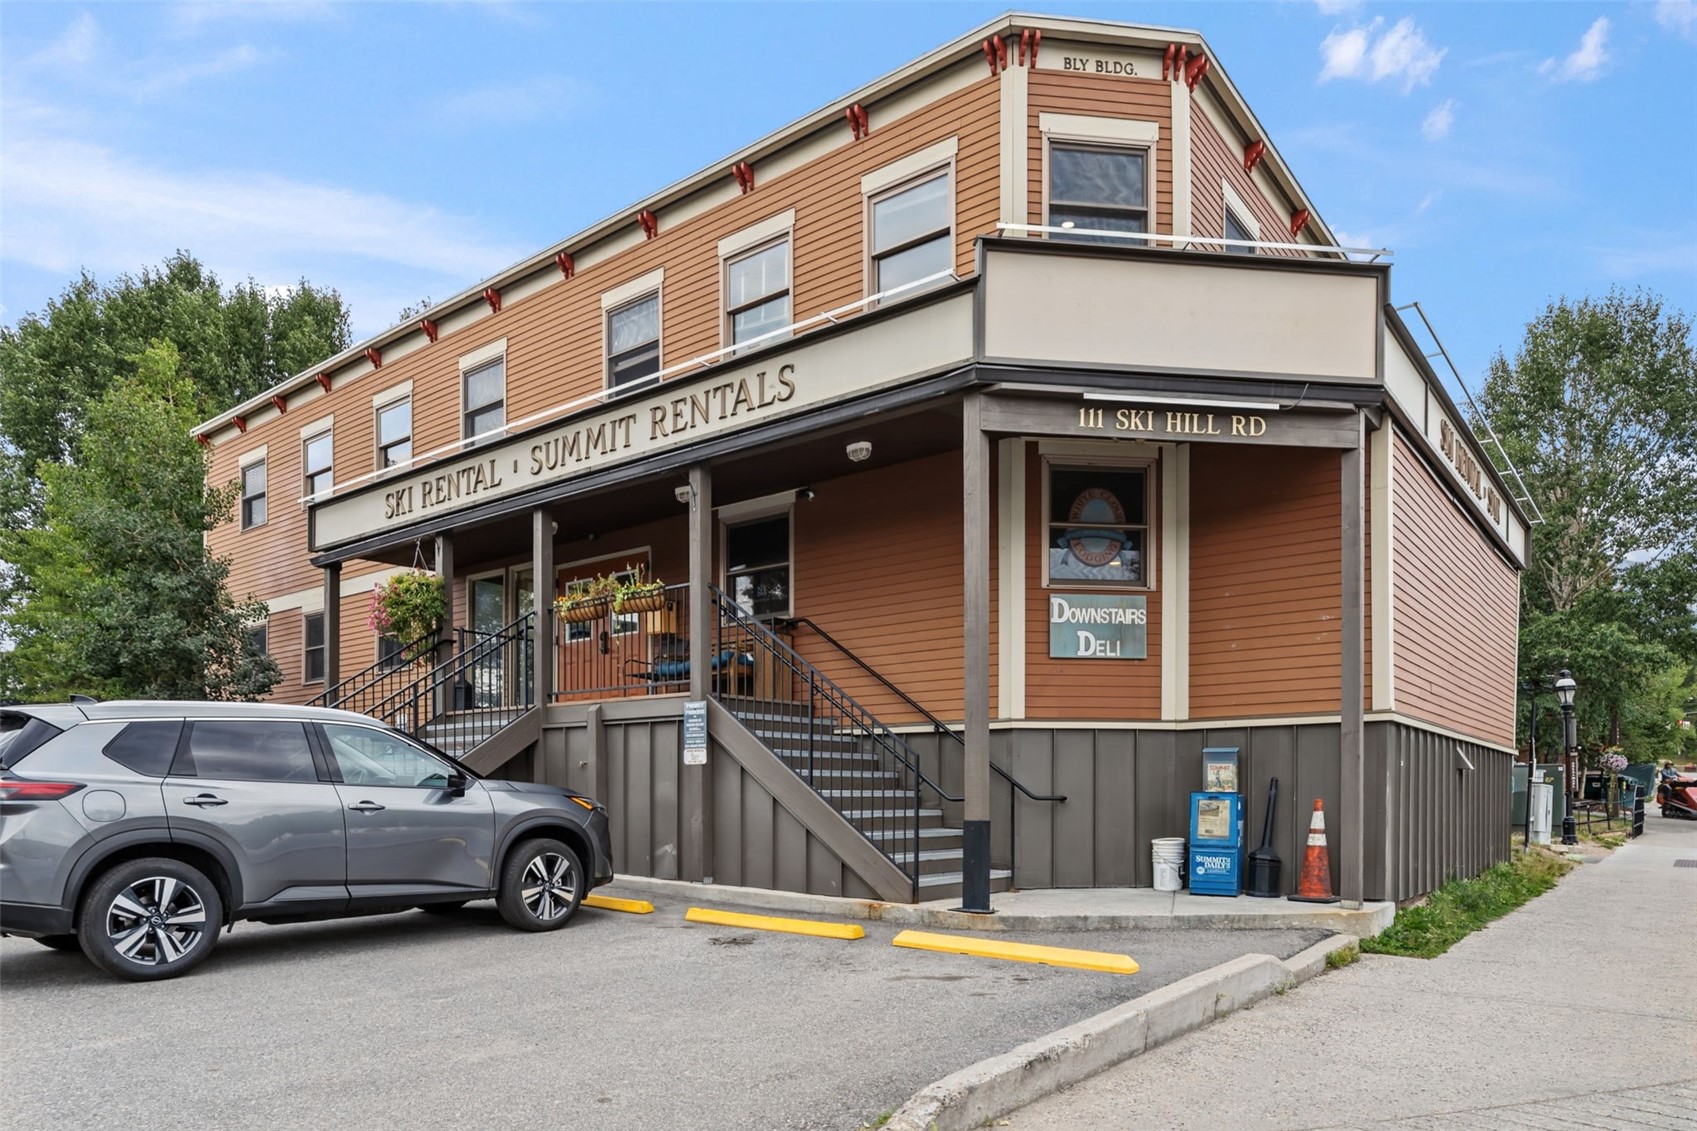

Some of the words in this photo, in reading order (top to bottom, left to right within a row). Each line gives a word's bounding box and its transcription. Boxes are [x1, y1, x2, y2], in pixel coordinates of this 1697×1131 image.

[1063, 57, 1089, 71] BLY
[1095, 60, 1138, 76] BLDG.
[1078, 407, 1104, 429] 111
[1115, 408, 1155, 432] SKI
[1165, 411, 1221, 436] HILL
[1230, 415, 1267, 437] RD
[385, 485, 414, 519] SKI
[421, 458, 502, 509] RENTAL
[530, 413, 636, 475] SUMMIT
[649, 363, 796, 440] RENTALS
[1073, 541, 1118, 563] LODGING
[1195, 855, 1226, 863] SUMMIT
